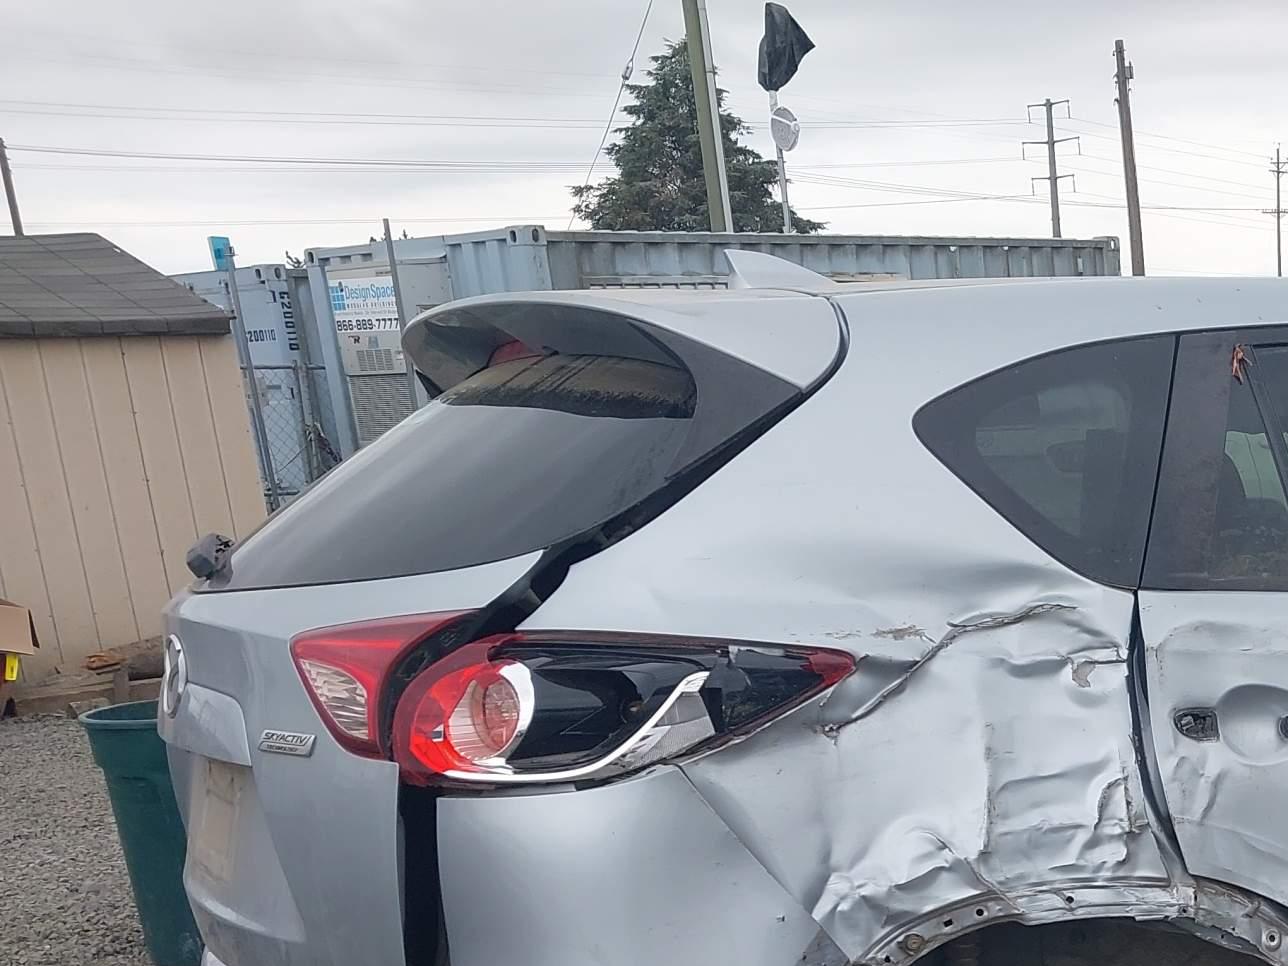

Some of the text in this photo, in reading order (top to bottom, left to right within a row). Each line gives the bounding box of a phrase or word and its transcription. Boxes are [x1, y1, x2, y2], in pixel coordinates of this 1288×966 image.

[344, 283, 395, 301] DesignSpace
[279, 291, 300, 351] G200110
[336, 318, 399, 332] 866-889-7777
[246, 329, 277, 342] 200110
[263, 732, 309, 744] SKYACTIV
